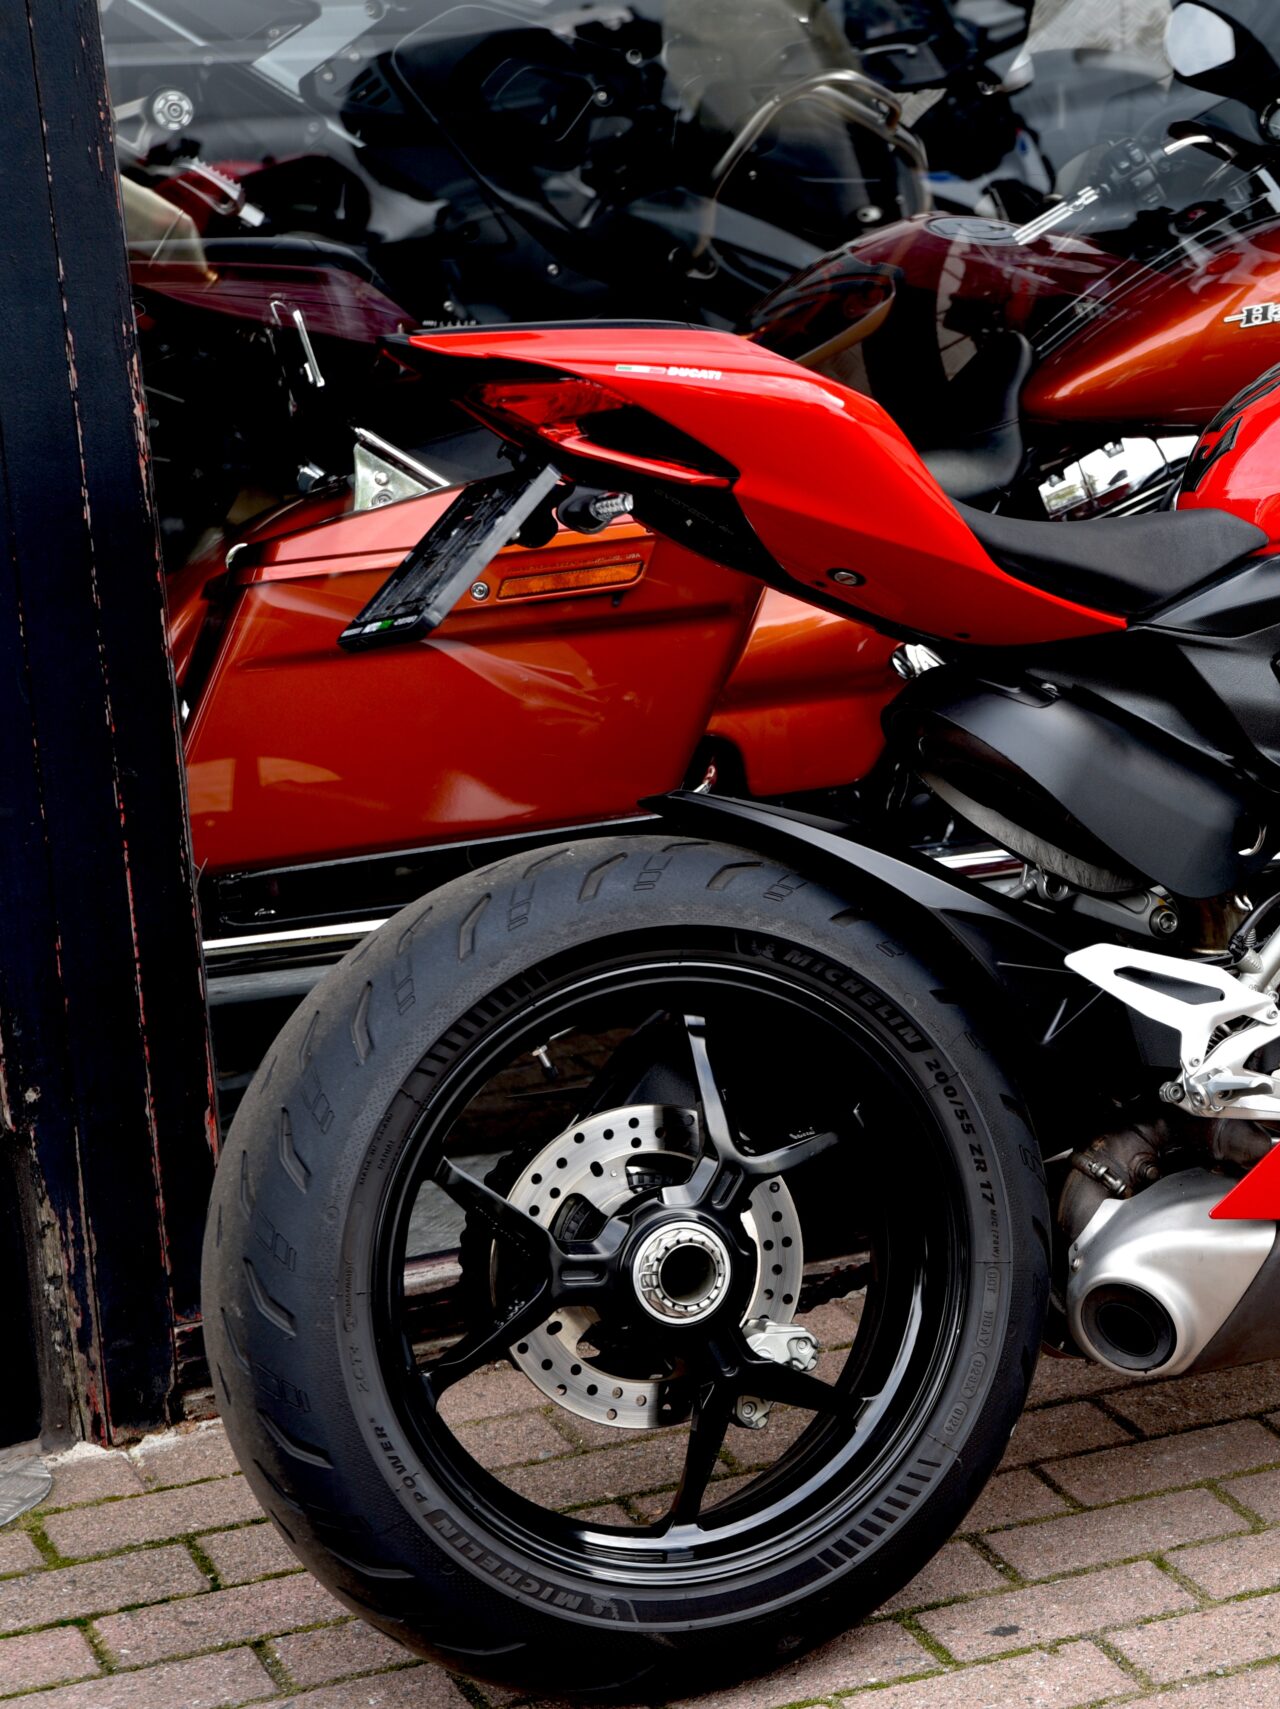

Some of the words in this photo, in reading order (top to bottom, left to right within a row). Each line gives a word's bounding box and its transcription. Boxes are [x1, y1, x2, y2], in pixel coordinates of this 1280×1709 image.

[667, 366, 722, 380] DUCATI
[783, 948, 922, 1046] MICHELIN
[925, 1058, 976, 1136] 200/55
[969, 1143, 988, 1173] ZR
[980, 1180, 996, 1206] 17
[432, 1517, 585, 1611] MICHELIN
